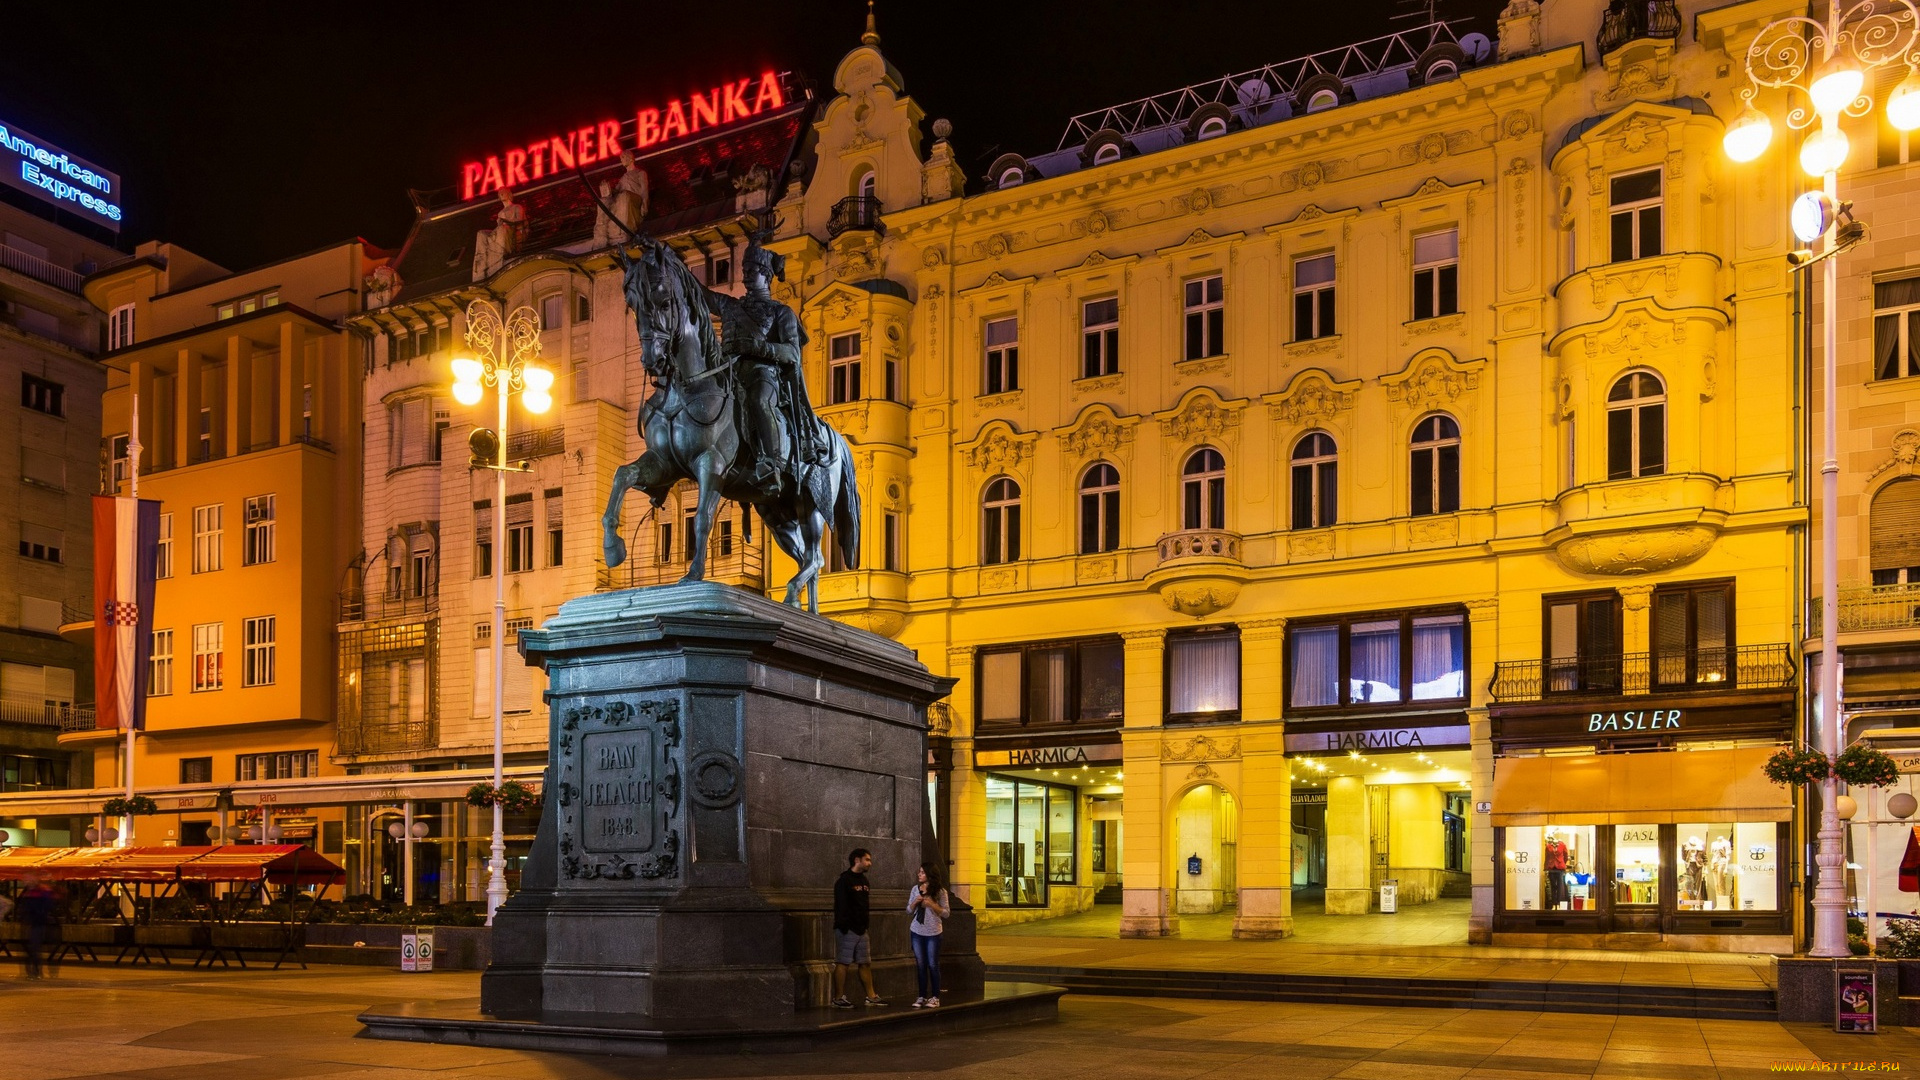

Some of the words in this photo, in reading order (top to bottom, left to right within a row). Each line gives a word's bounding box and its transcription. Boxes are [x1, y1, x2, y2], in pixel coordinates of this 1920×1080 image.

[462, 118, 622, 201] PARTNER
[637, 70, 784, 149] BANKA
[0, 124, 111, 194] American
[21, 160, 122, 221] Express
[1588, 709, 1681, 732] BASLER
[1327, 730, 1424, 750] HARMICA
[598, 745, 636, 770] BAN
[1009, 746, 1089, 765] HARMICA
[1622, 830, 1658, 842] BASL
[1741, 863, 1775, 872] BASLER
